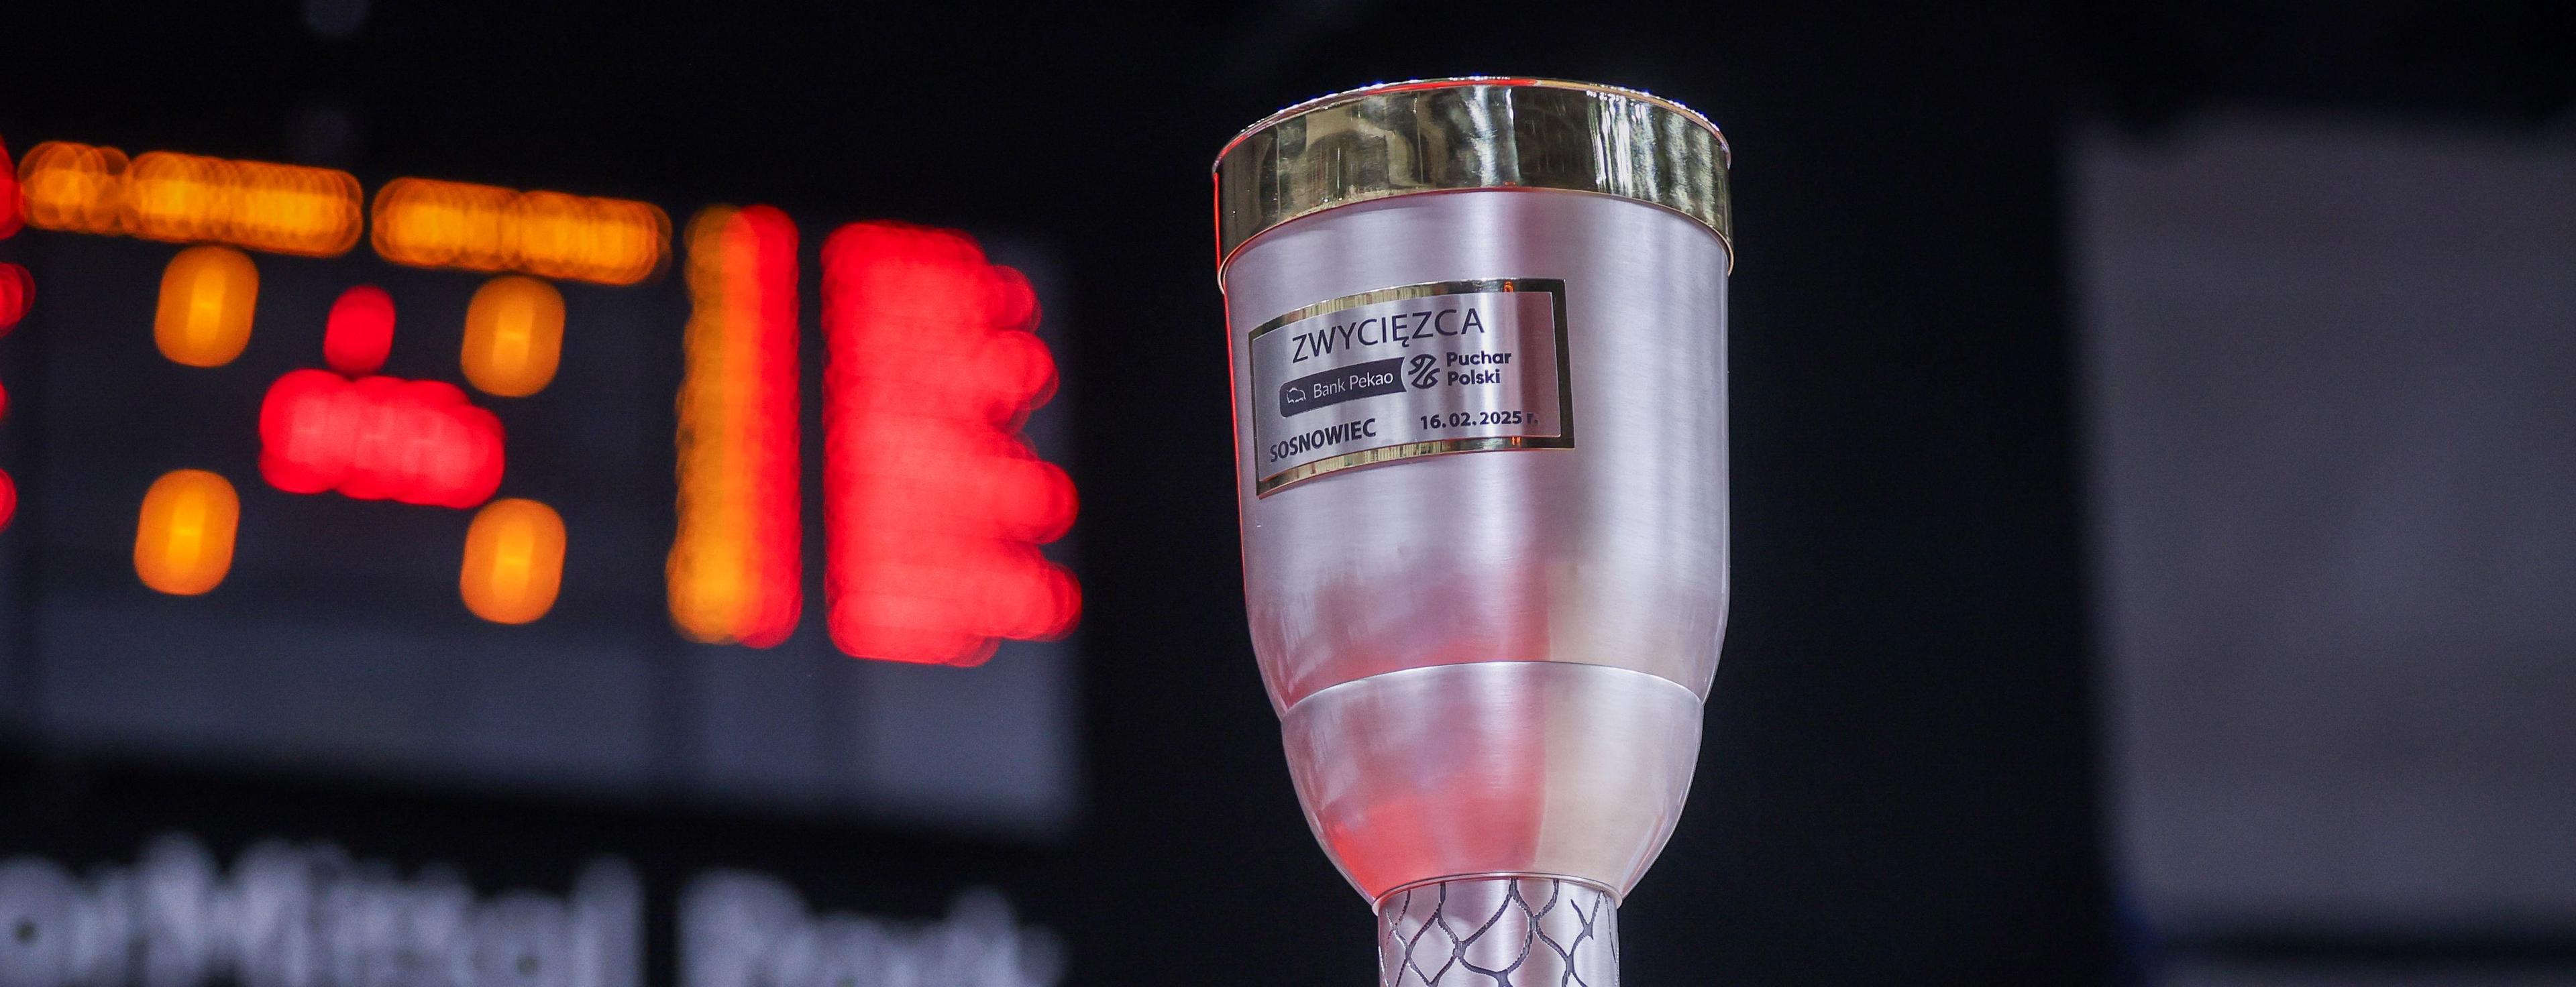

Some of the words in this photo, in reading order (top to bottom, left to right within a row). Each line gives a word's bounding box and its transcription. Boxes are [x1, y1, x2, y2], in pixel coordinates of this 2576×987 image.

[1292, 308, 1485, 363] ZWYCIĘZCA
[1446, 351, 1512, 367] Puchar
[1313, 378, 1346, 399] Bank
[1349, 371, 1393, 390] Pekao
[1447, 369, 1501, 386] Polski
[1270, 418, 1377, 463] SOSNOWIEC
